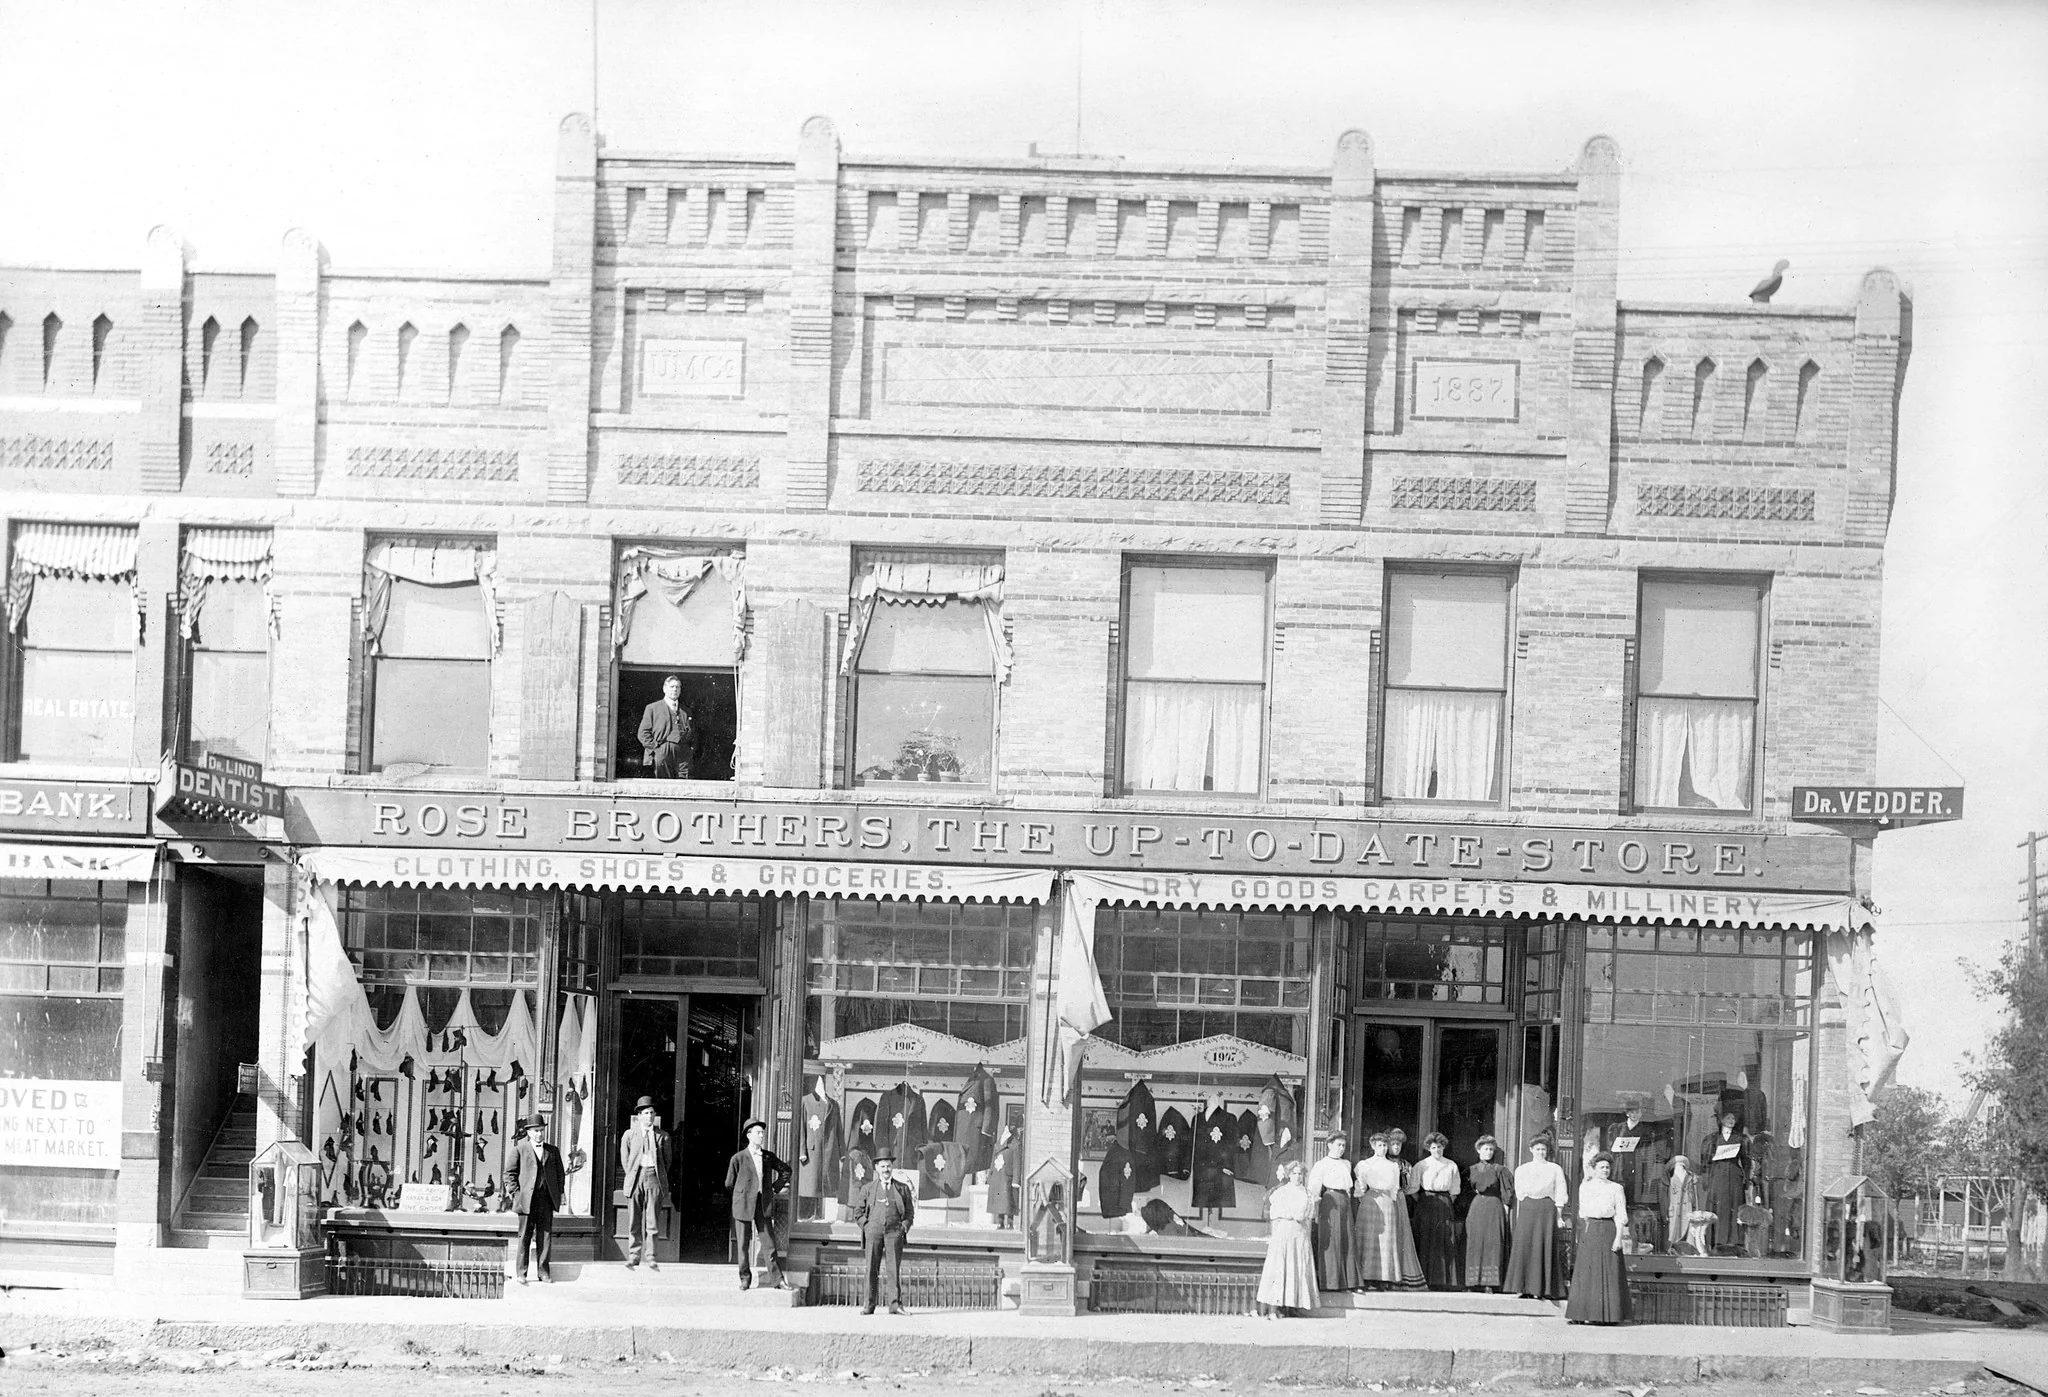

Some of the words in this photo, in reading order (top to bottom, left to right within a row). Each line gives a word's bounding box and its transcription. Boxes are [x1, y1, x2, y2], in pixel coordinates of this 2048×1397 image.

[24, 698, 65, 717] REAL
[226, 760, 258, 781] LIND.
[373, 803, 528, 838] ROSE
[927, 818, 1055, 855] THE
[579, 858, 685, 882] SHOES
[711, 863, 728, 884] &
[1142, 876, 1202, 898] DRY
[1231, 879, 1338, 900] GOODS
[1364, 881, 1515, 905] CARPETS
[1542, 886, 1558, 907] &
[895, 1041, 916, 1051] 1907
[26, 1117, 68, 1134] NEXT
[76, 1119, 95, 1135] TO
